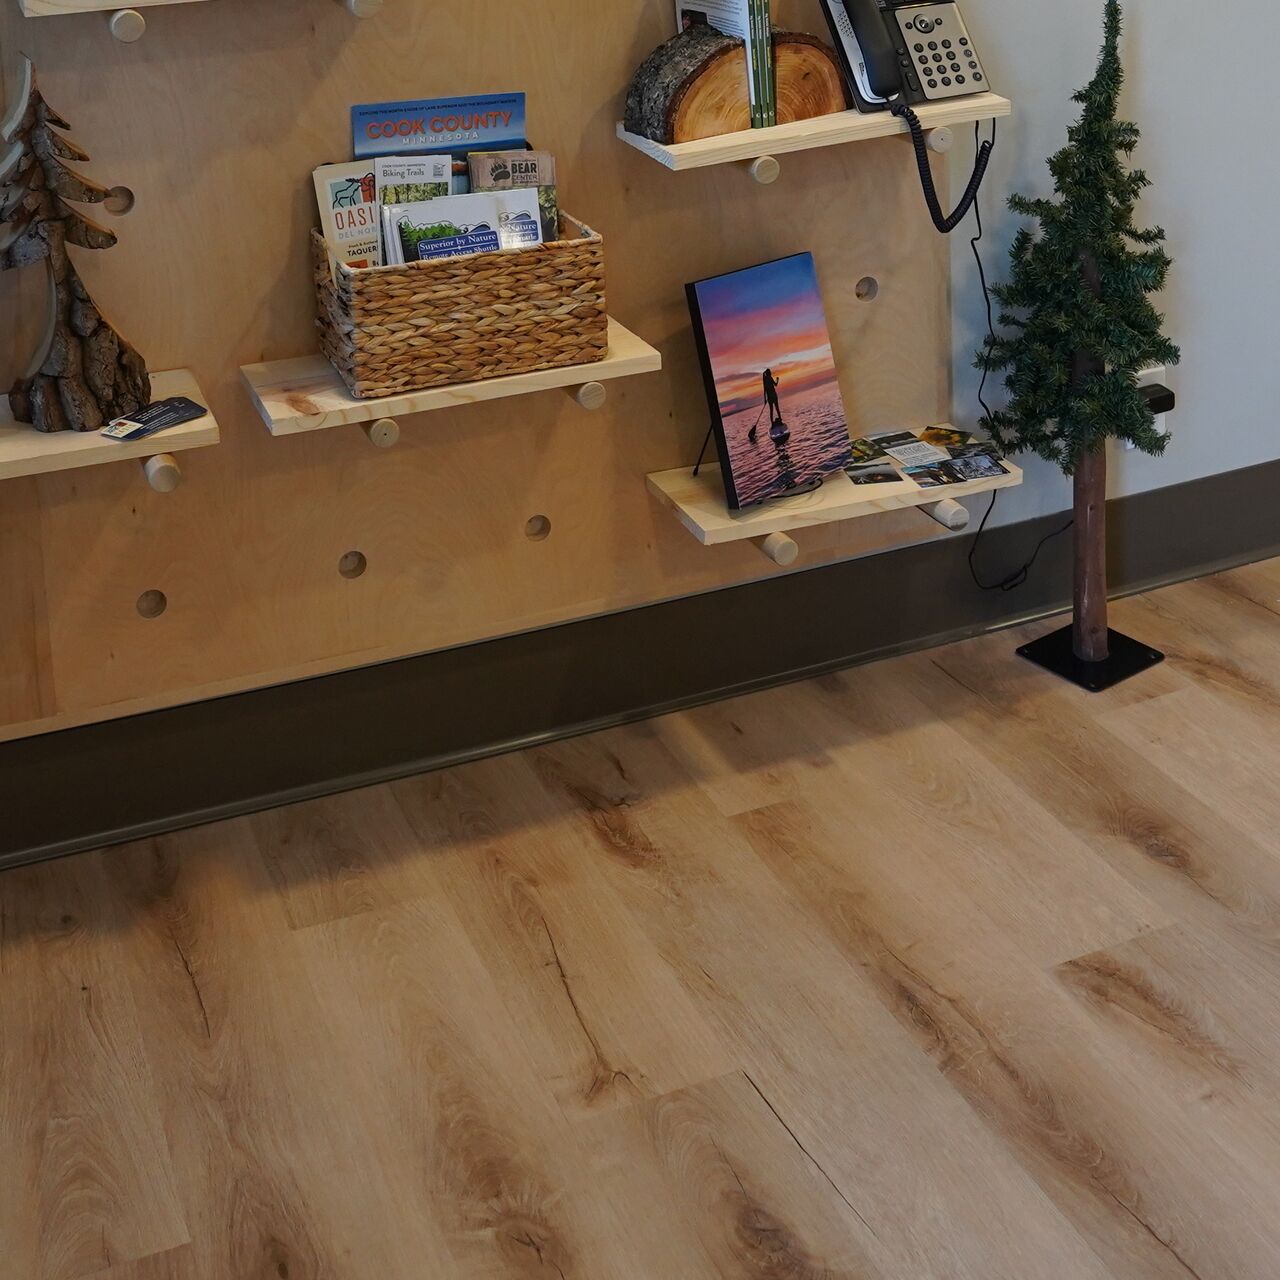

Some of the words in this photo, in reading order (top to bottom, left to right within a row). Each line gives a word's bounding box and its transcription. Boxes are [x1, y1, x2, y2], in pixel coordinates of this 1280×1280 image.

[366, 119, 426, 139] COOK
[428, 111, 513, 133] COUNTY
[402, 131, 480, 145] MINNESOTA
[382, 169, 406, 180] Biking
[406, 168, 425, 176] Trails
[512, 162, 538, 174] BEAR
[508, 222, 537, 232] Nature
[338, 231, 354, 240] DEL
[420, 241, 455, 252] Superior
[456, 237, 466, 247] by
[468, 233, 496, 244] Nature
[346, 247, 378, 257] TAQUER
[422, 252, 450, 260] Remote
[450, 249, 473, 257] Access
[474, 244, 498, 254] Shuttle
